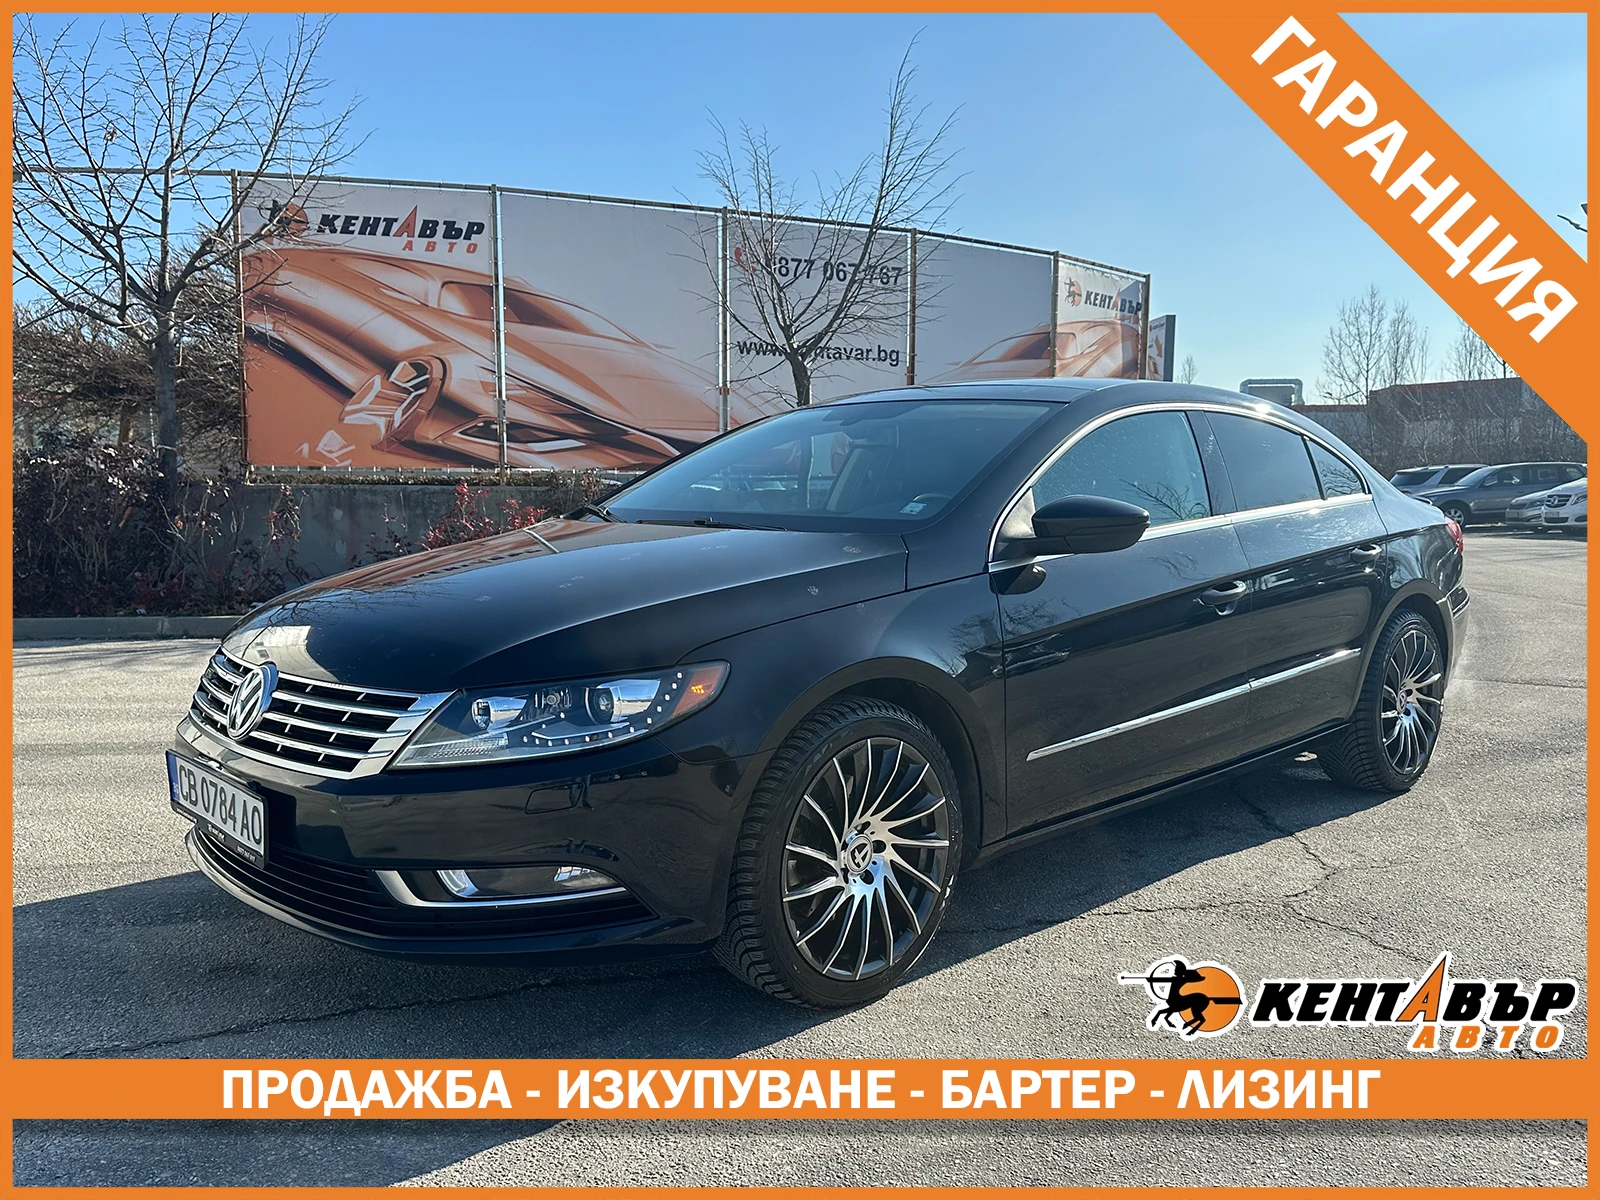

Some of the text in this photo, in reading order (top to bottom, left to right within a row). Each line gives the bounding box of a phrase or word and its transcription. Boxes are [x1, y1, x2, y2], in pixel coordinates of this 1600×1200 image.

[316, 204, 486, 241] КЕНТАВЪР
[401, 240, 478, 254] АВТО
[764, 256, 815, 279] 877
[1084, 287, 1142, 315] КЕНТАВЪР
[178, 763, 262, 846] CB 0784 AO
